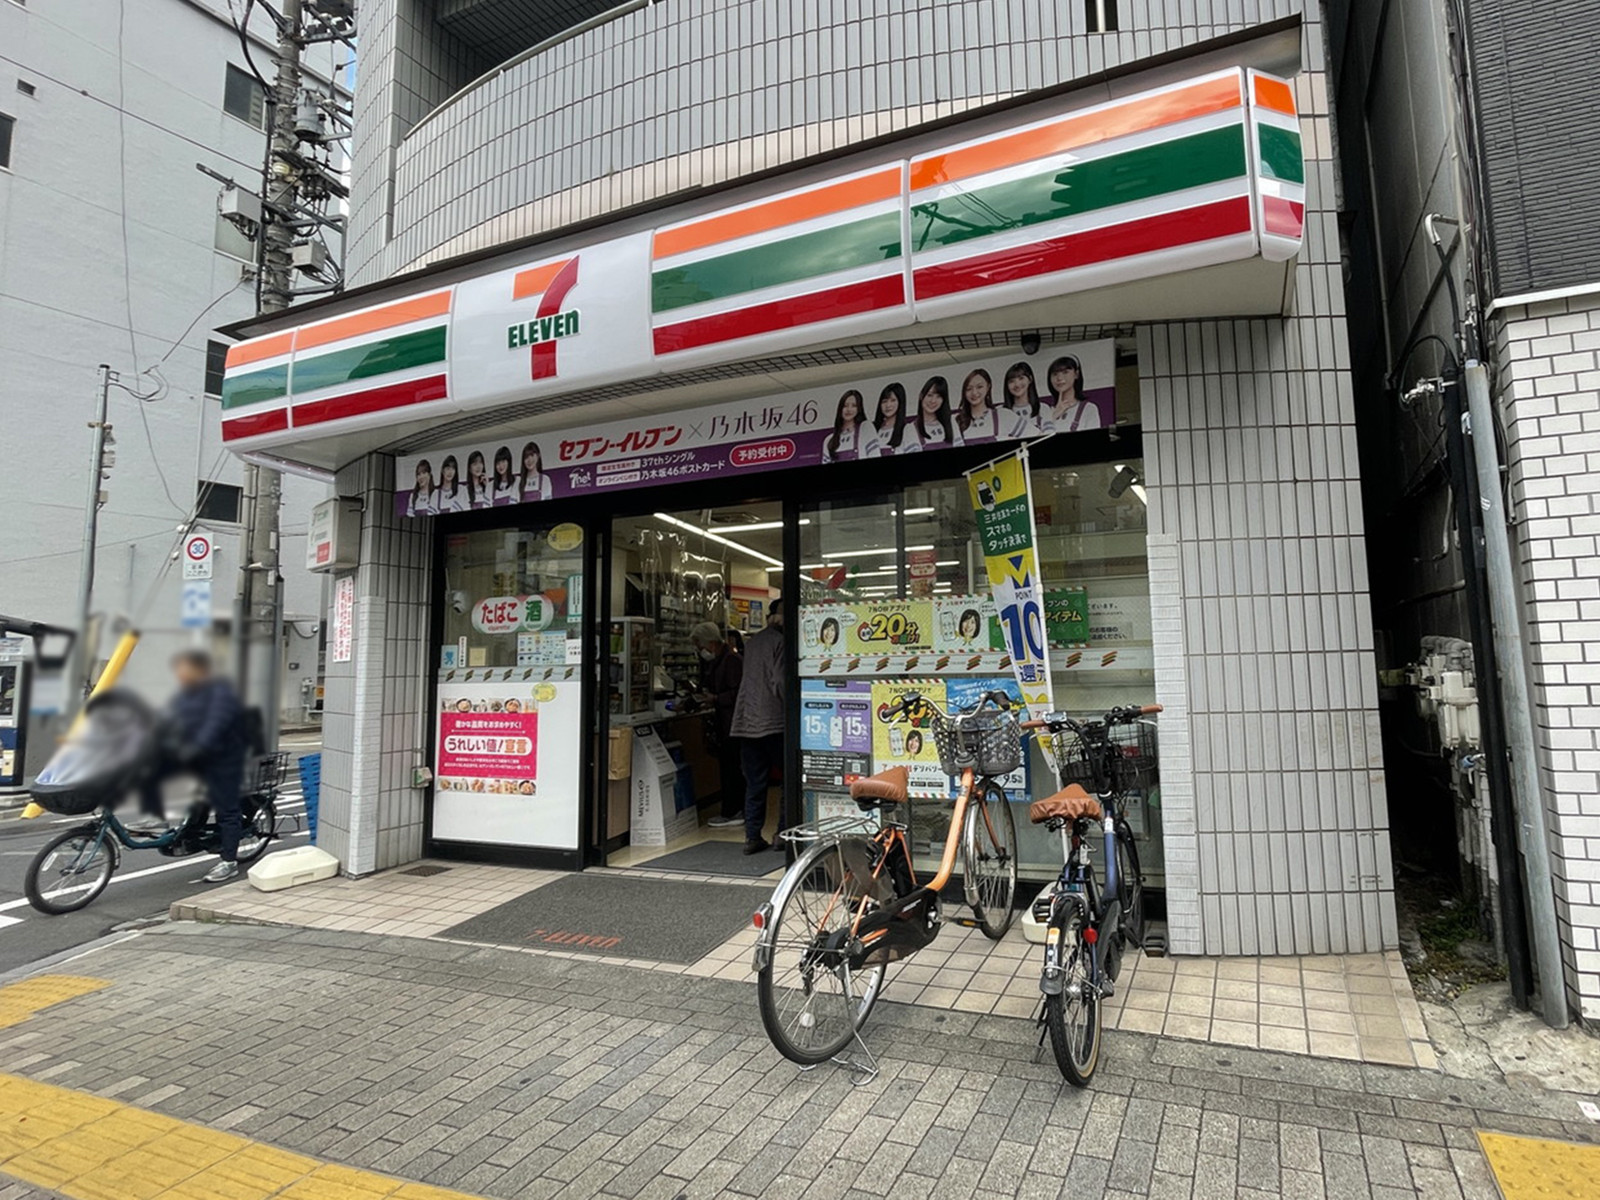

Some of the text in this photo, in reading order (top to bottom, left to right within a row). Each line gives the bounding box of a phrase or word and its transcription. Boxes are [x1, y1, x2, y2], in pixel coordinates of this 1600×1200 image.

[708, 400, 818, 440] 乃木坂46
[738, 445, 788, 461] 予約受付中
[641, 460, 726, 481] 乃木坂46ポストカード
[191, 543, 205, 554] 30
[481, 601, 518, 624] たばこ
[525, 600, 542, 622] 酒
